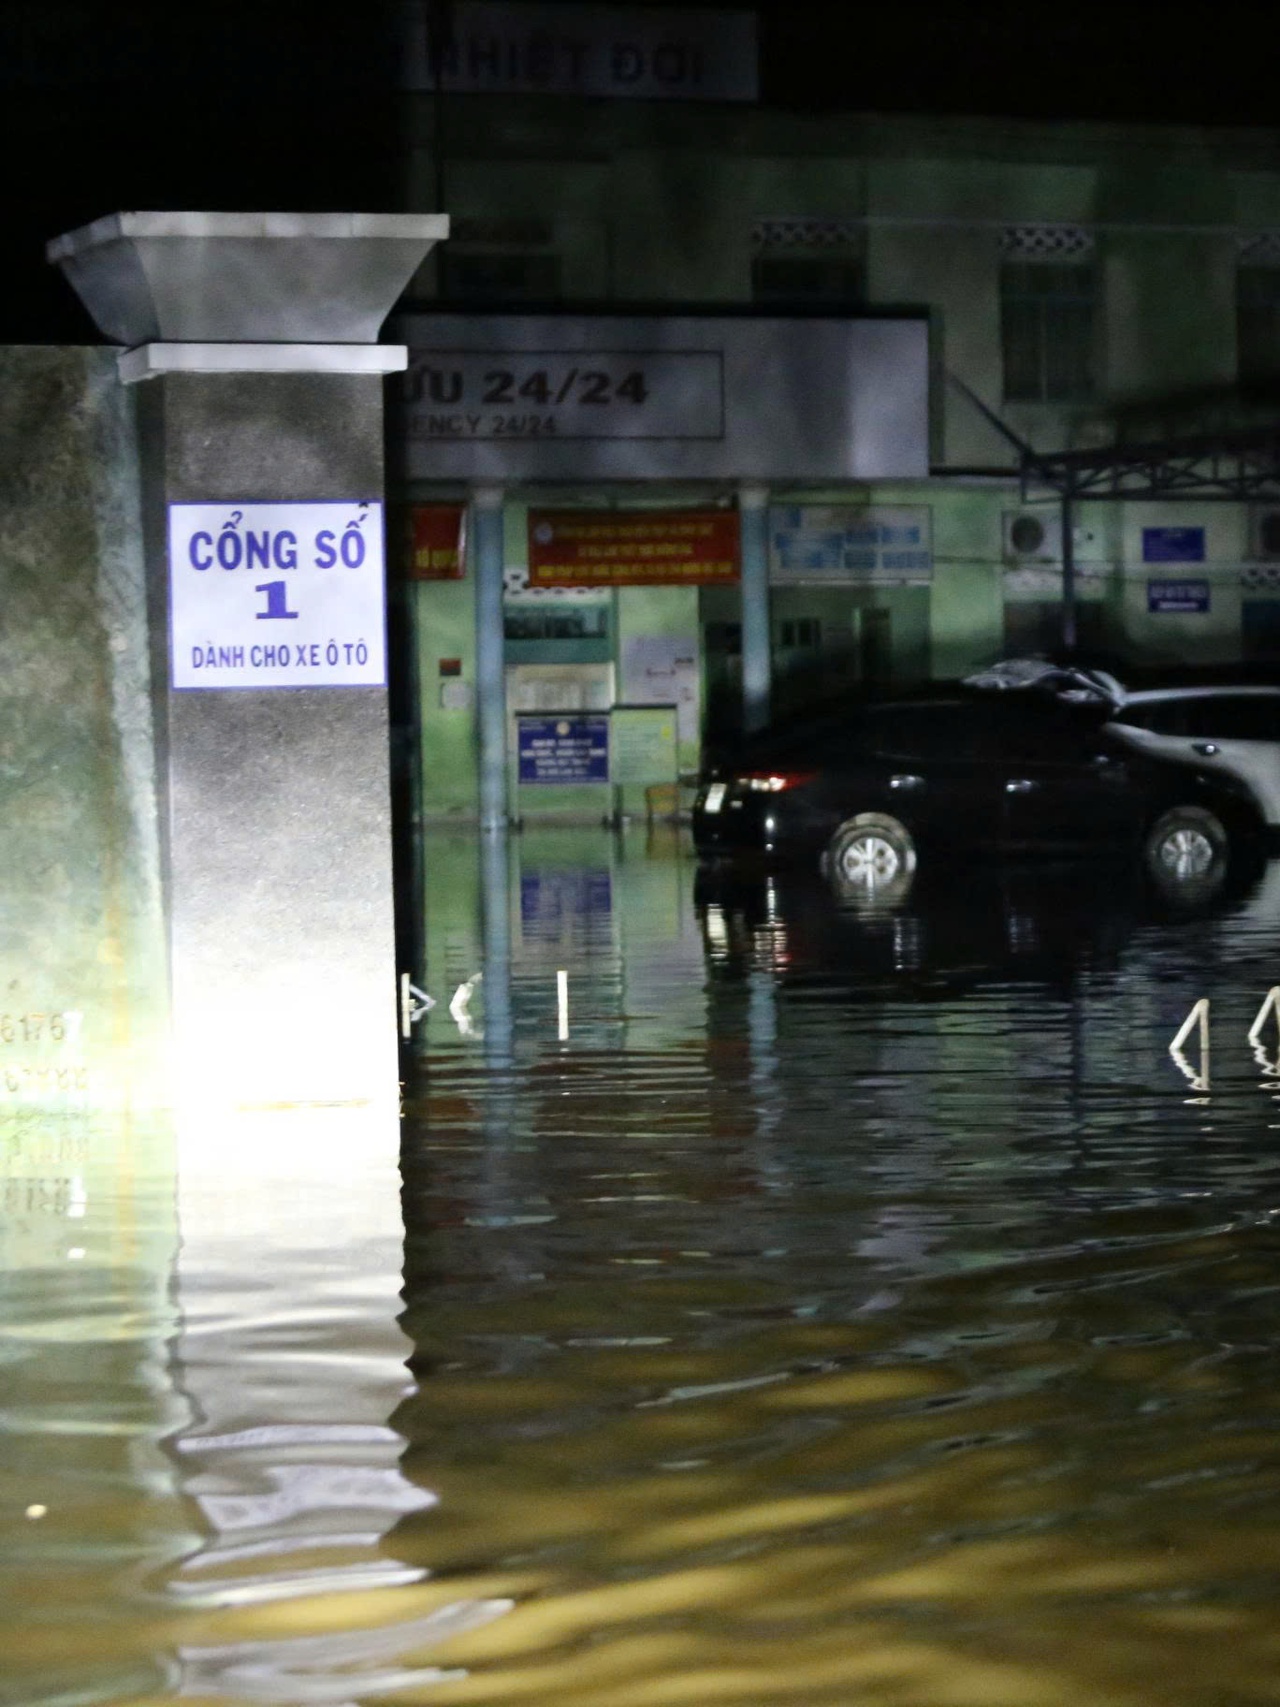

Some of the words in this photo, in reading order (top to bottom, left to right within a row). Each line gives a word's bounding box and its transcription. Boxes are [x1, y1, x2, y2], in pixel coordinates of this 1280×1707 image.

[482, 367, 648, 404] 24/24
[492, 415, 557, 434] 24/24
[189, 510, 298, 571] CỔNG
[314, 513, 367, 570] SỐ
[255, 580, 299, 620] 1
[192, 640, 245, 669] DÀNH
[250, 644, 291, 668] CHO
[295, 643, 321, 667] XE
